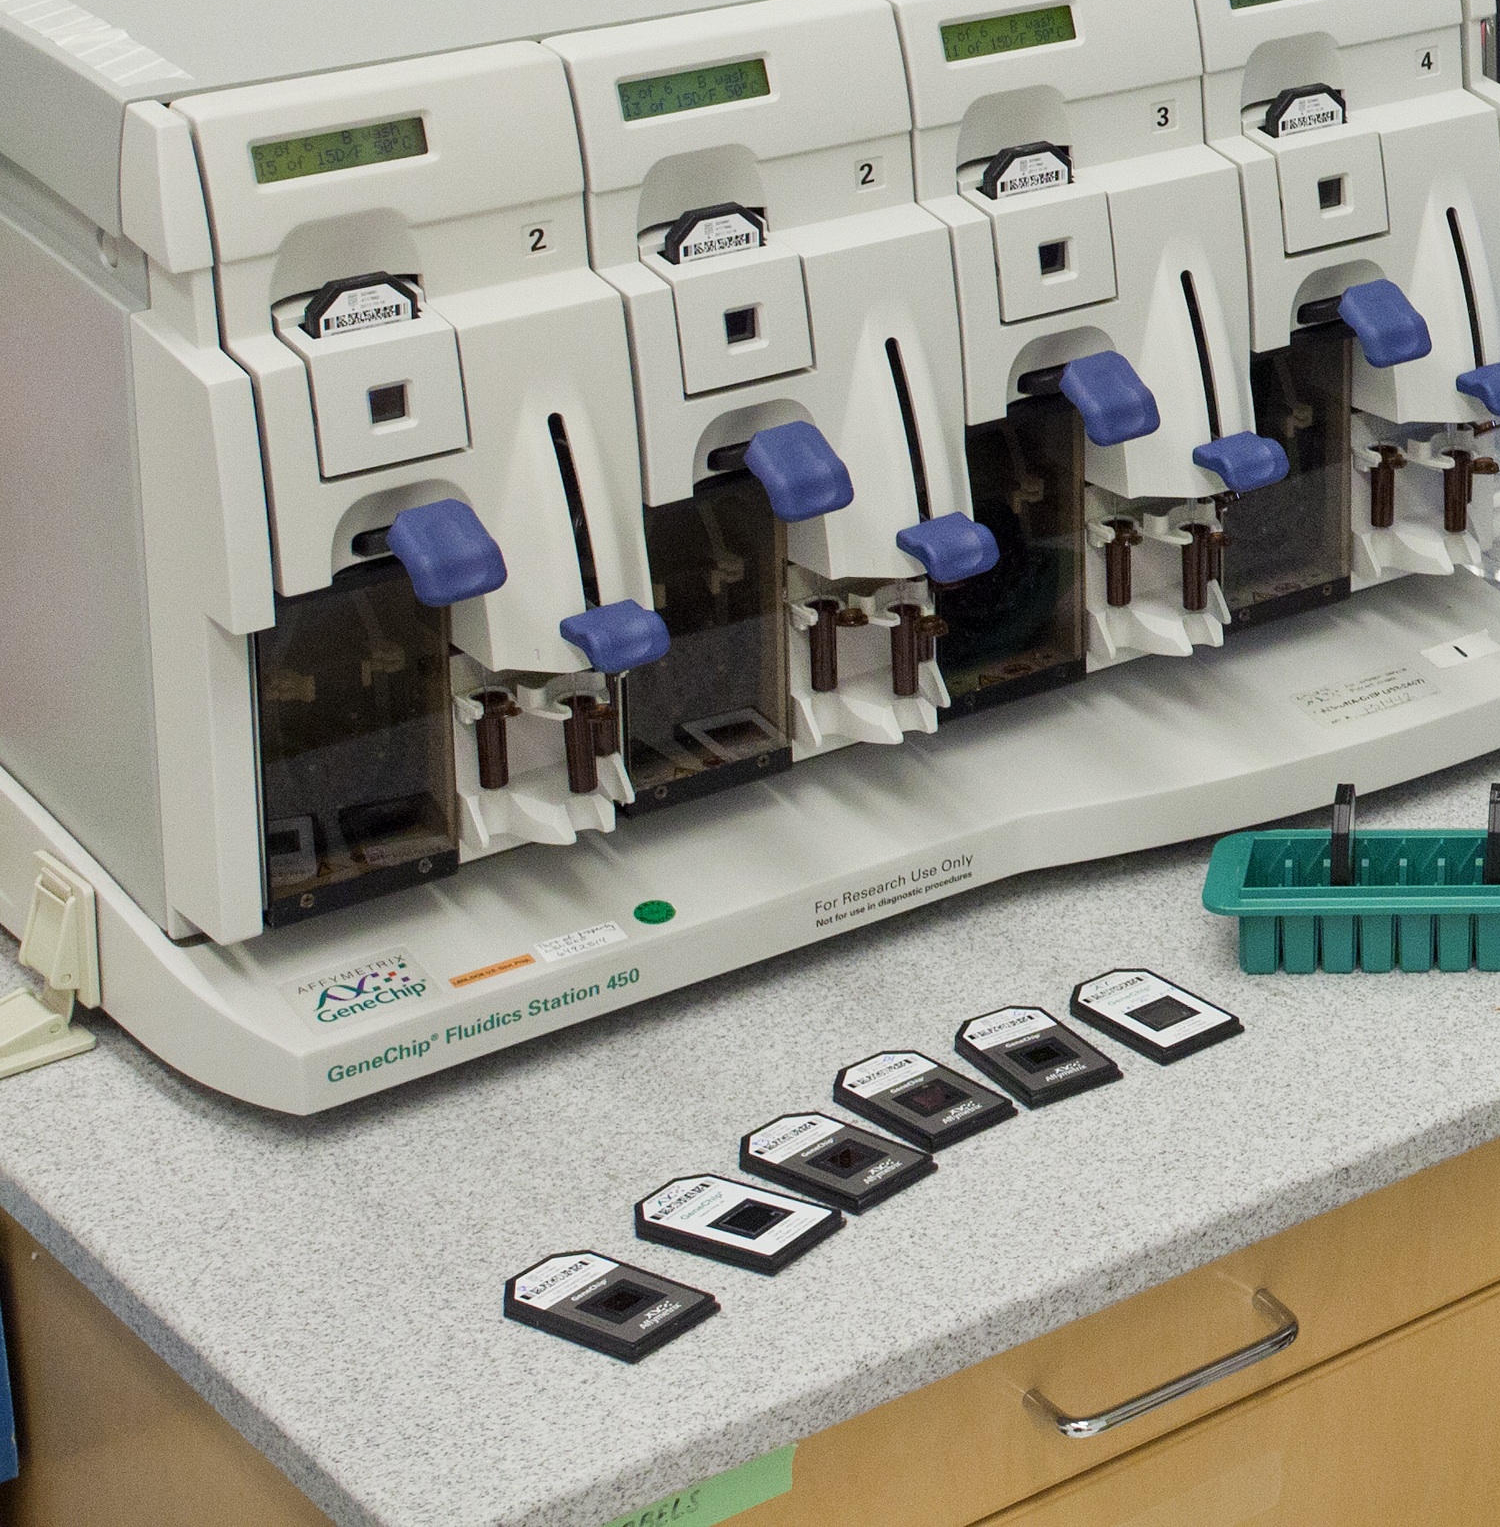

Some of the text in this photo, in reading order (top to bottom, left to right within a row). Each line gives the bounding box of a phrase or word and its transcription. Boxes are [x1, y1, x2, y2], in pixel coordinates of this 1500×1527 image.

[1421, 51, 1433, 70] 4
[1157, 106, 1169, 127] 3
[342, 129, 352, 145] B
[361, 123, 399, 141] wash
[287, 156, 304, 171] of
[859, 163, 875, 185] 2
[529, 228, 547, 252] 2
[814, 854, 974, 914] For Research Use Only
[816, 871, 973, 928] Not for use in diagnostic procedures
[297, 955, 406, 994] AFFYMETRIX
[445, 1010, 523, 1045] Fluidics
[528, 984, 600, 1018] Station
[606, 968, 640, 991] 450
